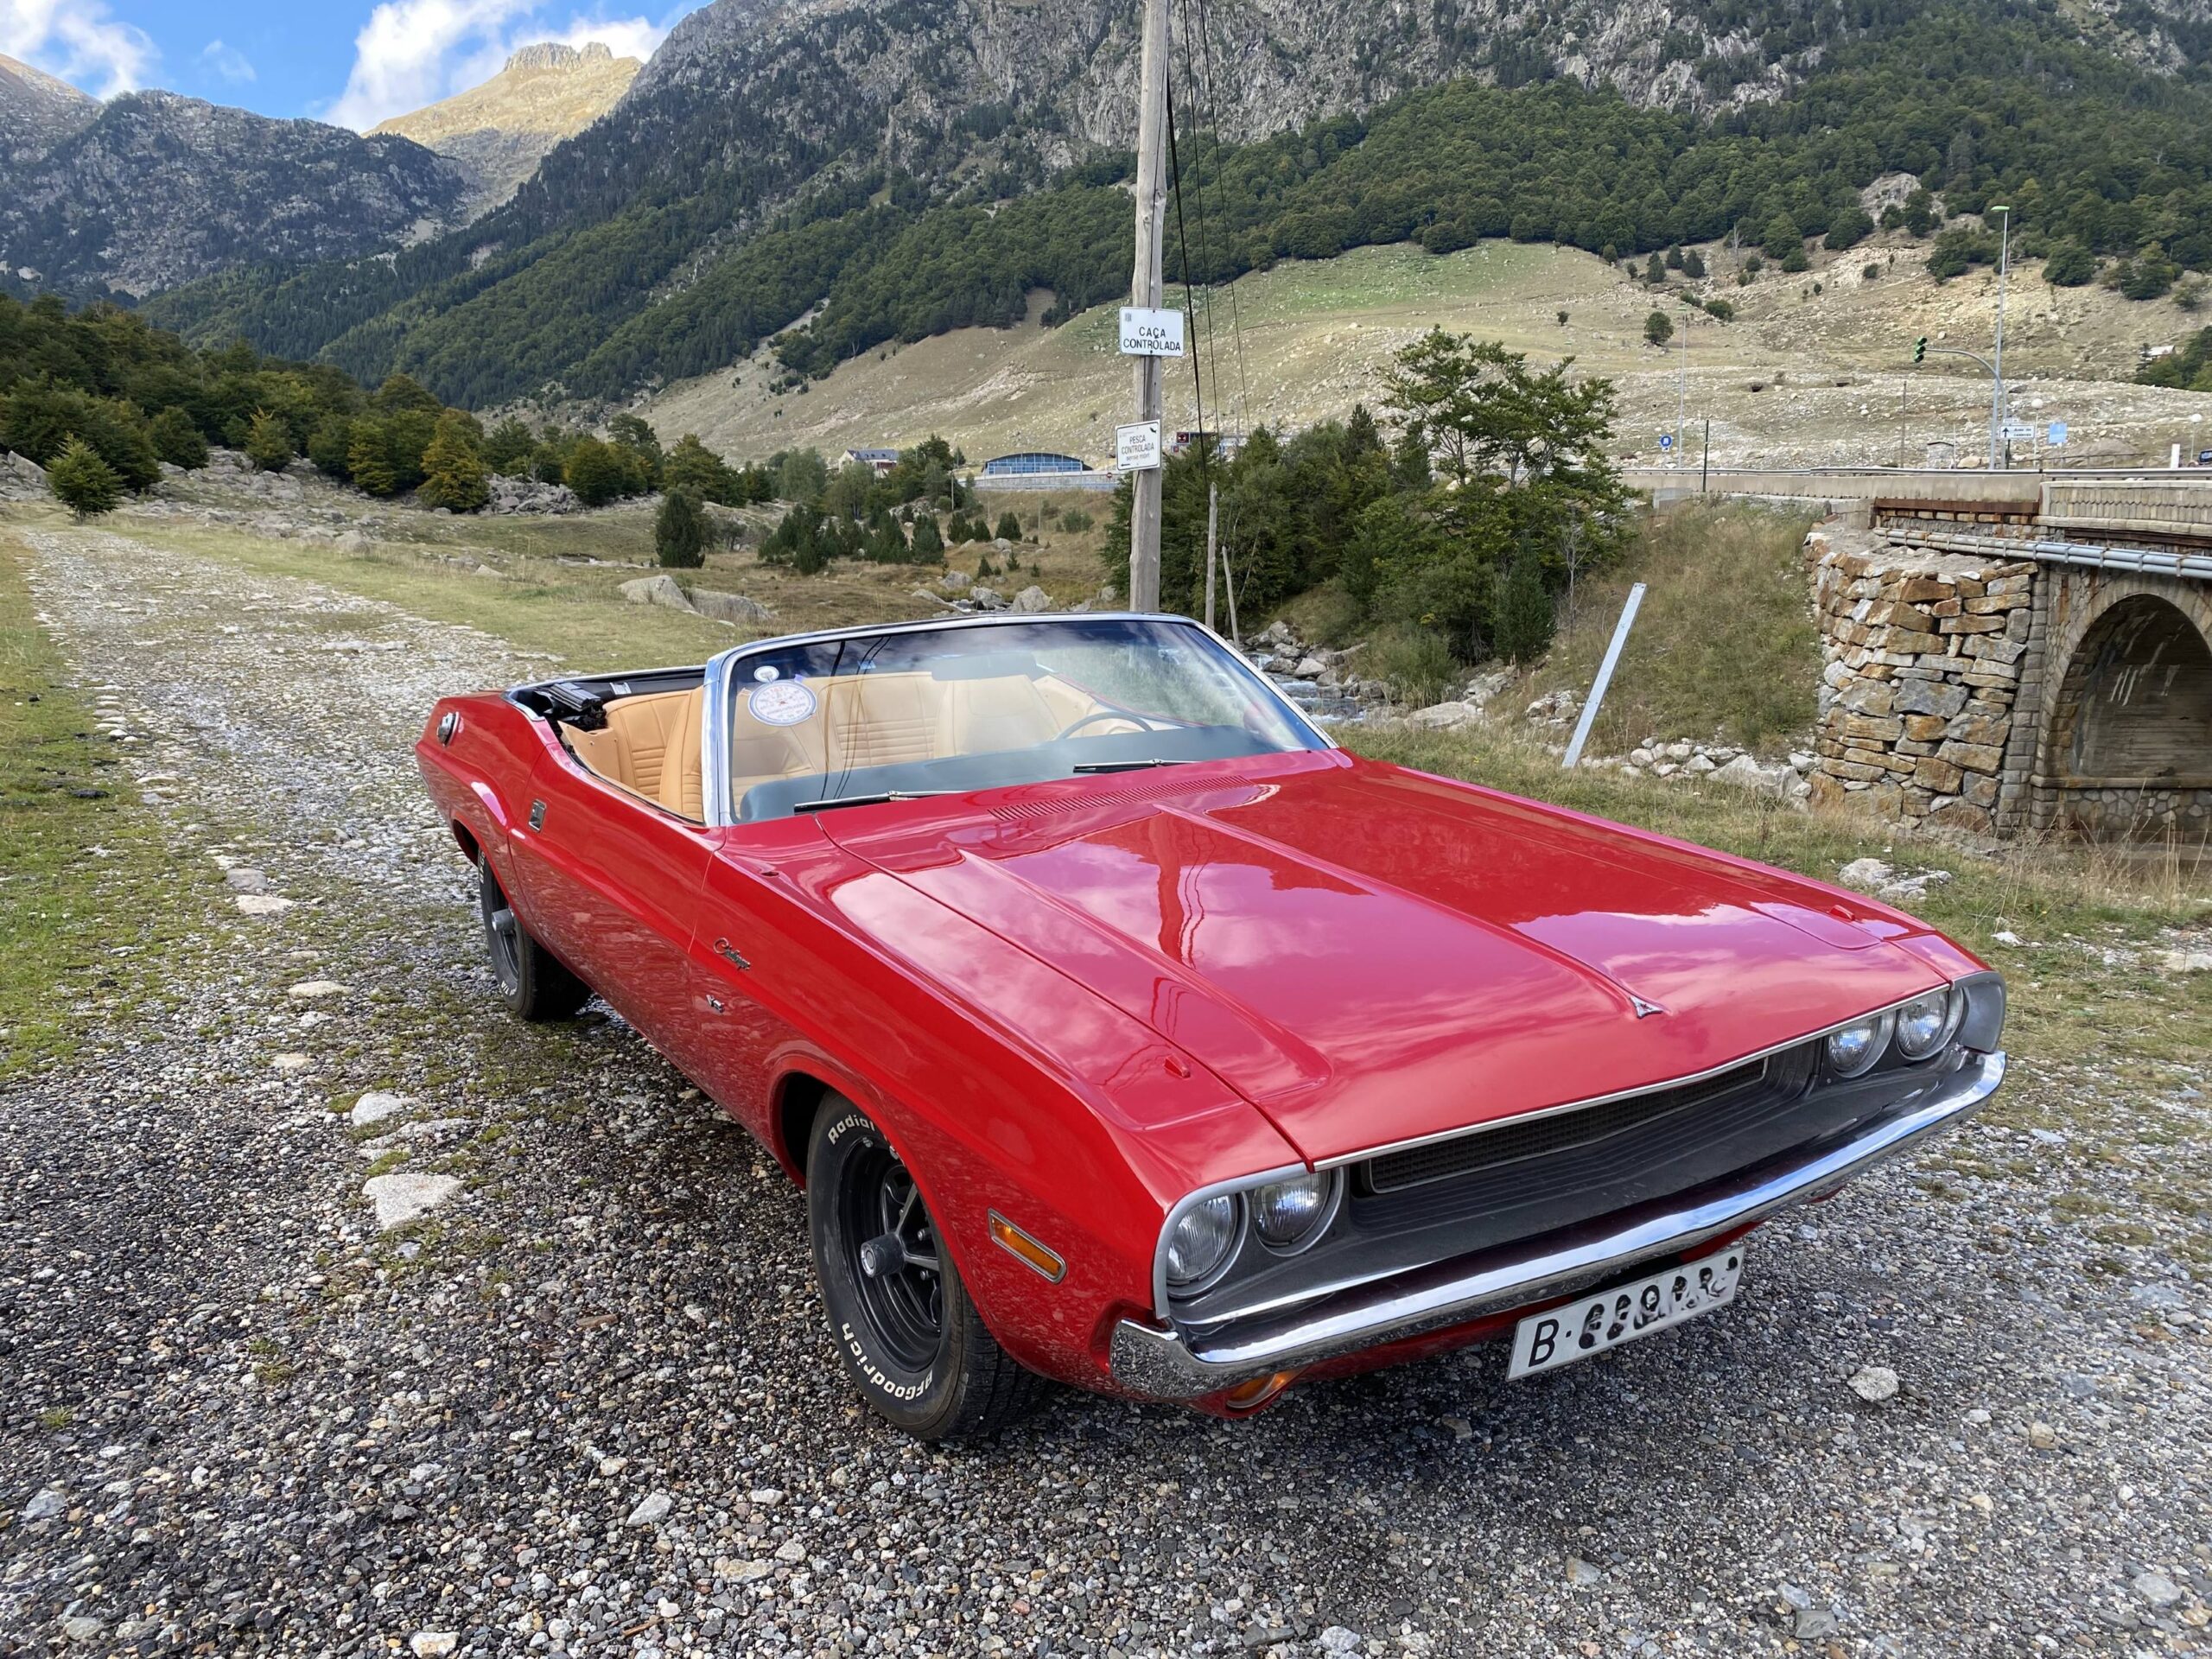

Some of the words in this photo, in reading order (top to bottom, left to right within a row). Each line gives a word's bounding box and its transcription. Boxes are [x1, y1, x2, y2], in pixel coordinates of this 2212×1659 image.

[1139, 326, 1166, 340] CAÇA
[1123, 338, 1181, 351] CONTROLADA
[1129, 435, 1146, 444] PESCA
[1121, 442, 1154, 454] CONTROLADA
[828, 1114, 875, 1146] Radial
[842, 1322, 933, 1401] BFGoodrich
